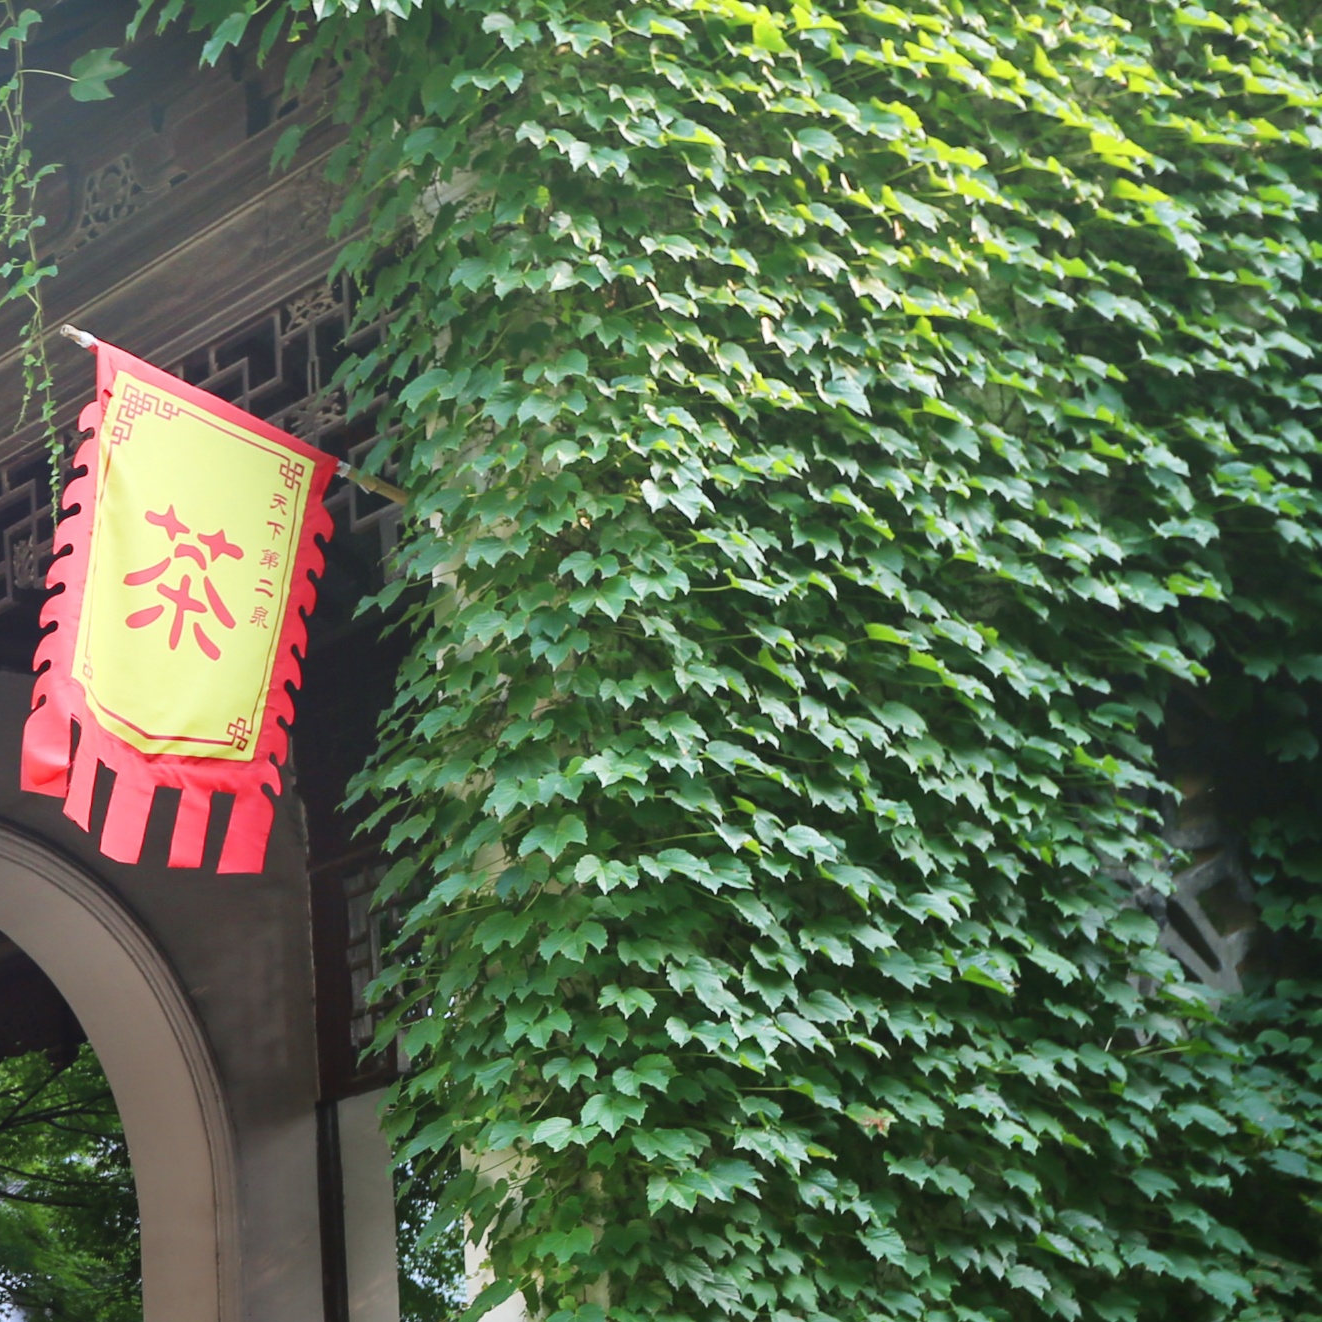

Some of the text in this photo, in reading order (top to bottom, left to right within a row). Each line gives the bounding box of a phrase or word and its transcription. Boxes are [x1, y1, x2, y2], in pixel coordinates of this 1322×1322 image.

[123, 504, 245, 661] 茶
[249, 493, 288, 630] 天下第二泉
